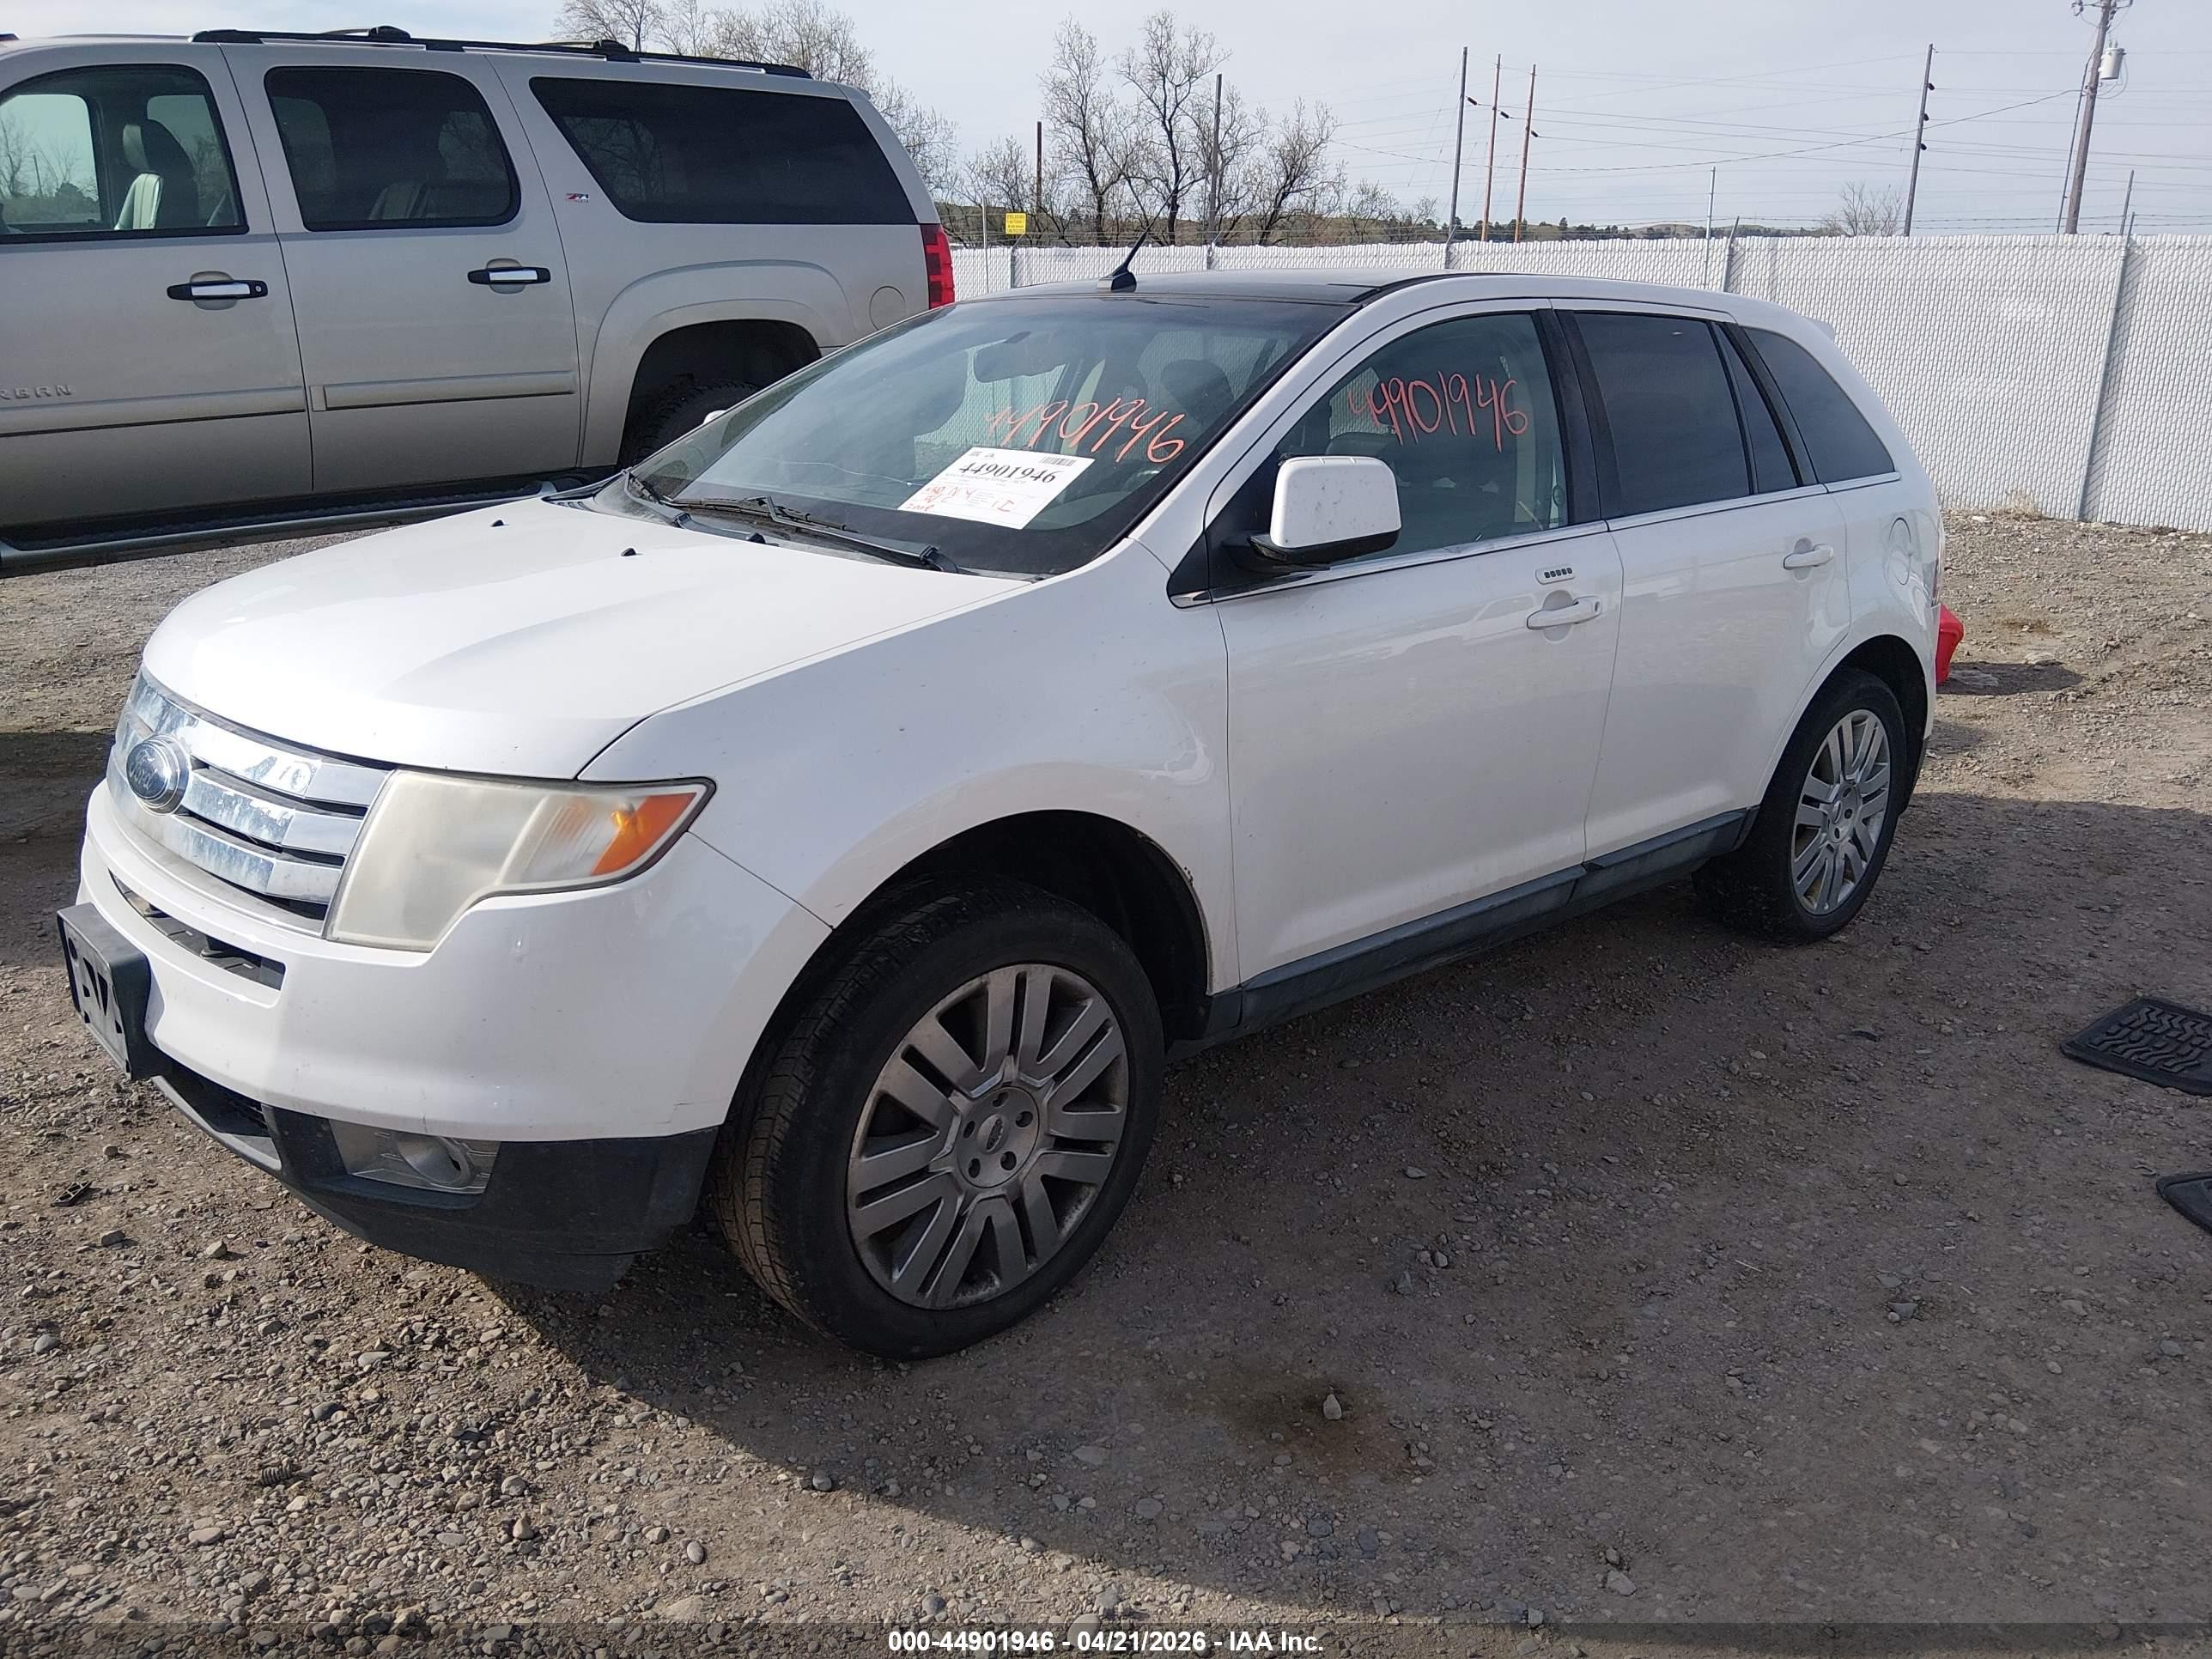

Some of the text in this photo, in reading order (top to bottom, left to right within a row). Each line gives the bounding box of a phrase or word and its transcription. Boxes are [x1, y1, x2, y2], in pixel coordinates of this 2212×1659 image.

[984, 398, 1185, 463] 44901946
[1347, 371, 1528, 453] 44901946
[958, 462, 1062, 483] 44901946
[129, 748, 157, 791] Ford
